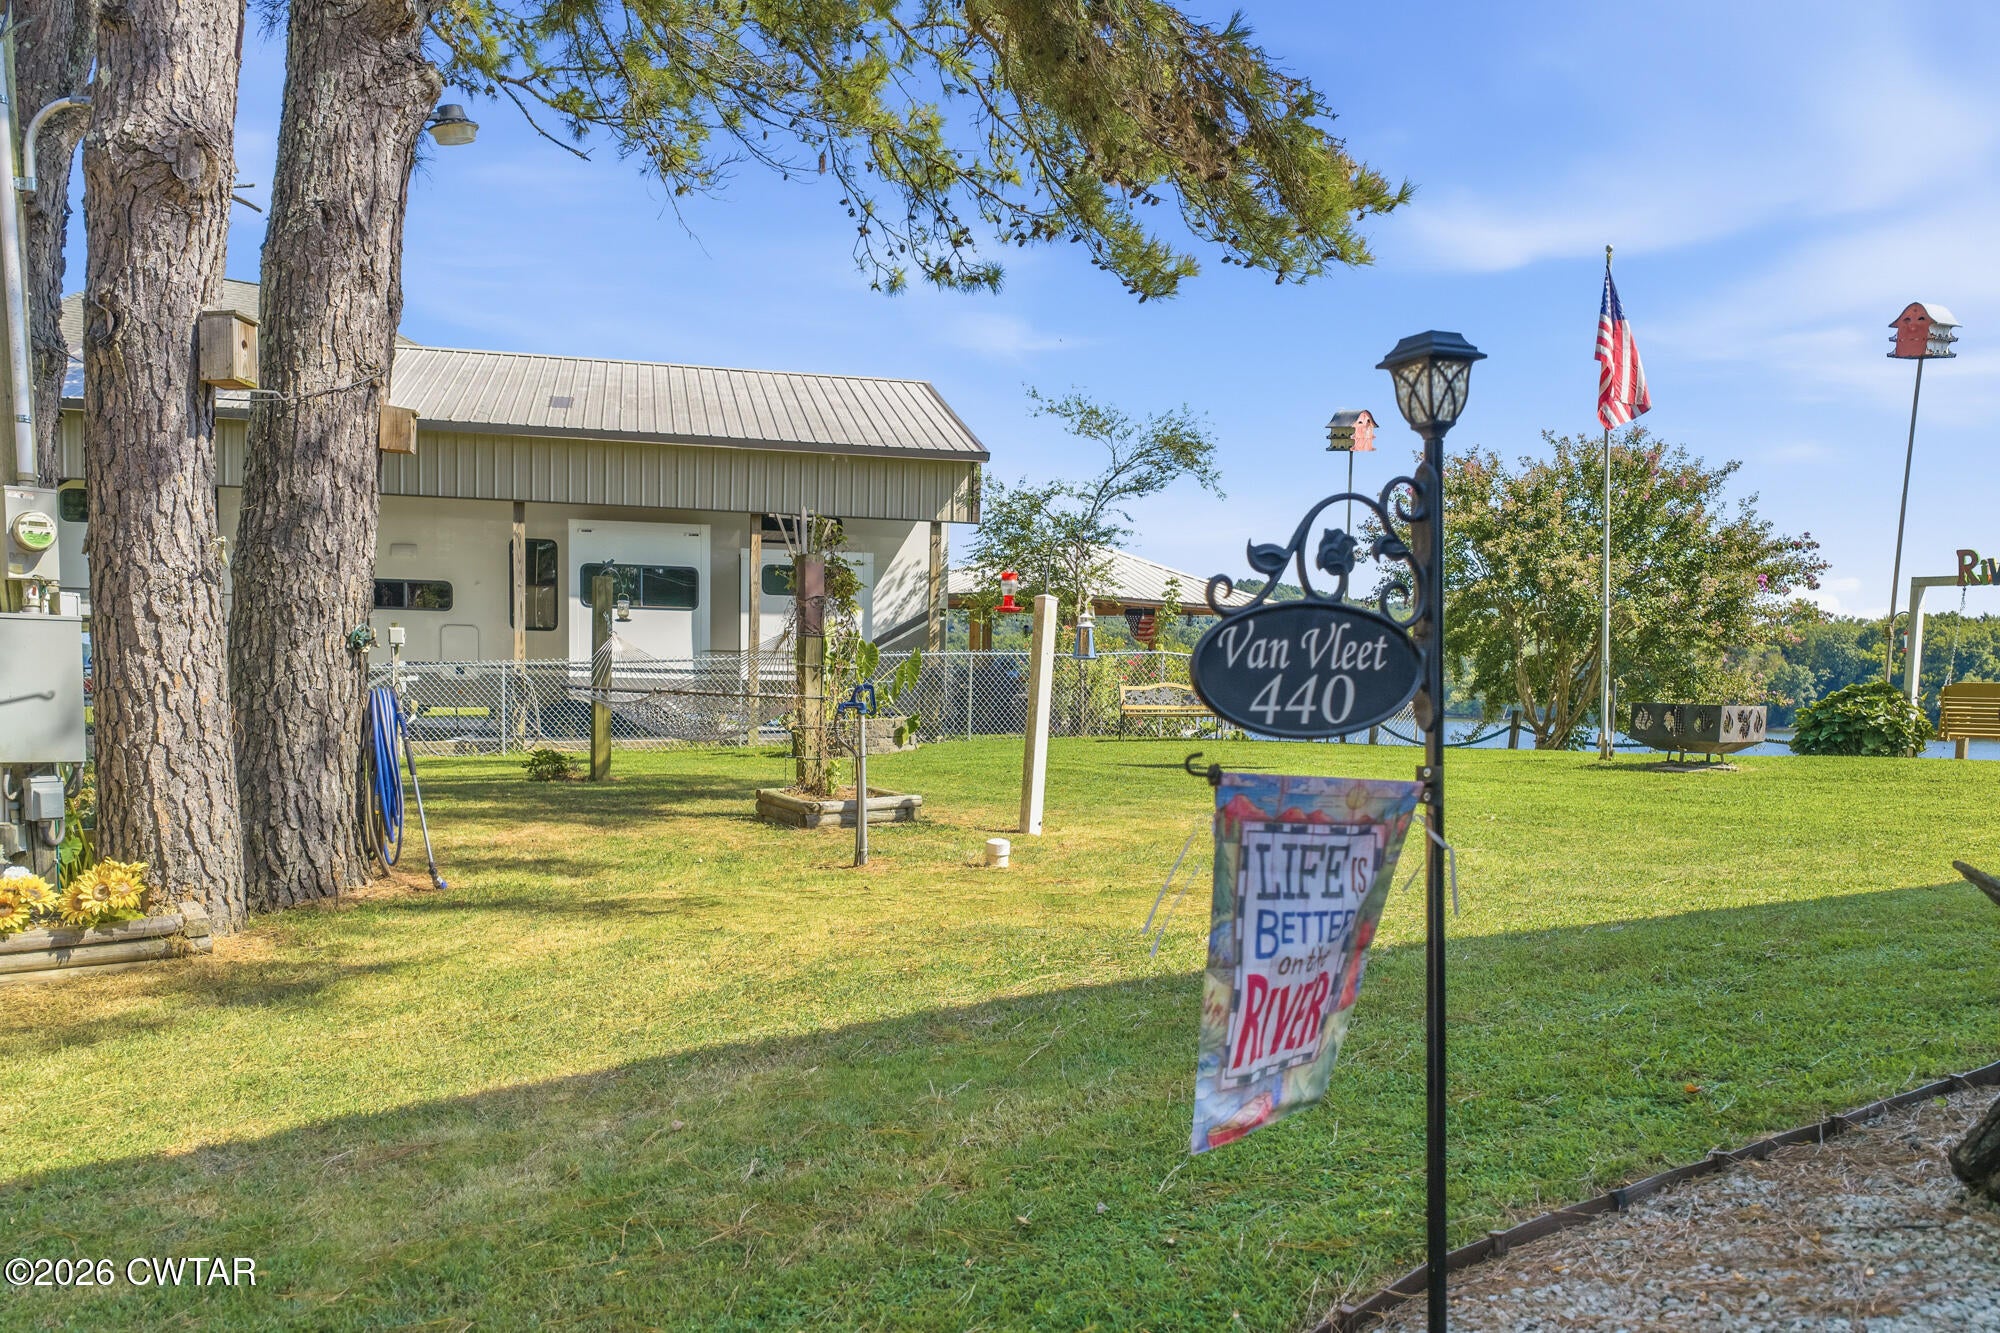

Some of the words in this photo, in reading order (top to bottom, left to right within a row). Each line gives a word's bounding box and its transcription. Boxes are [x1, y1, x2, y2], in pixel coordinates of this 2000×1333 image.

[1217, 620, 1290, 669] Van
[1301, 622, 1388, 671] Vleet
[1249, 673, 1355, 724] 440
[1256, 843, 1350, 900] LIFE
[1351, 856, 1367, 893] IS
[1278, 956, 1303, 976] on
[1232, 971, 1330, 1069] RIVER
